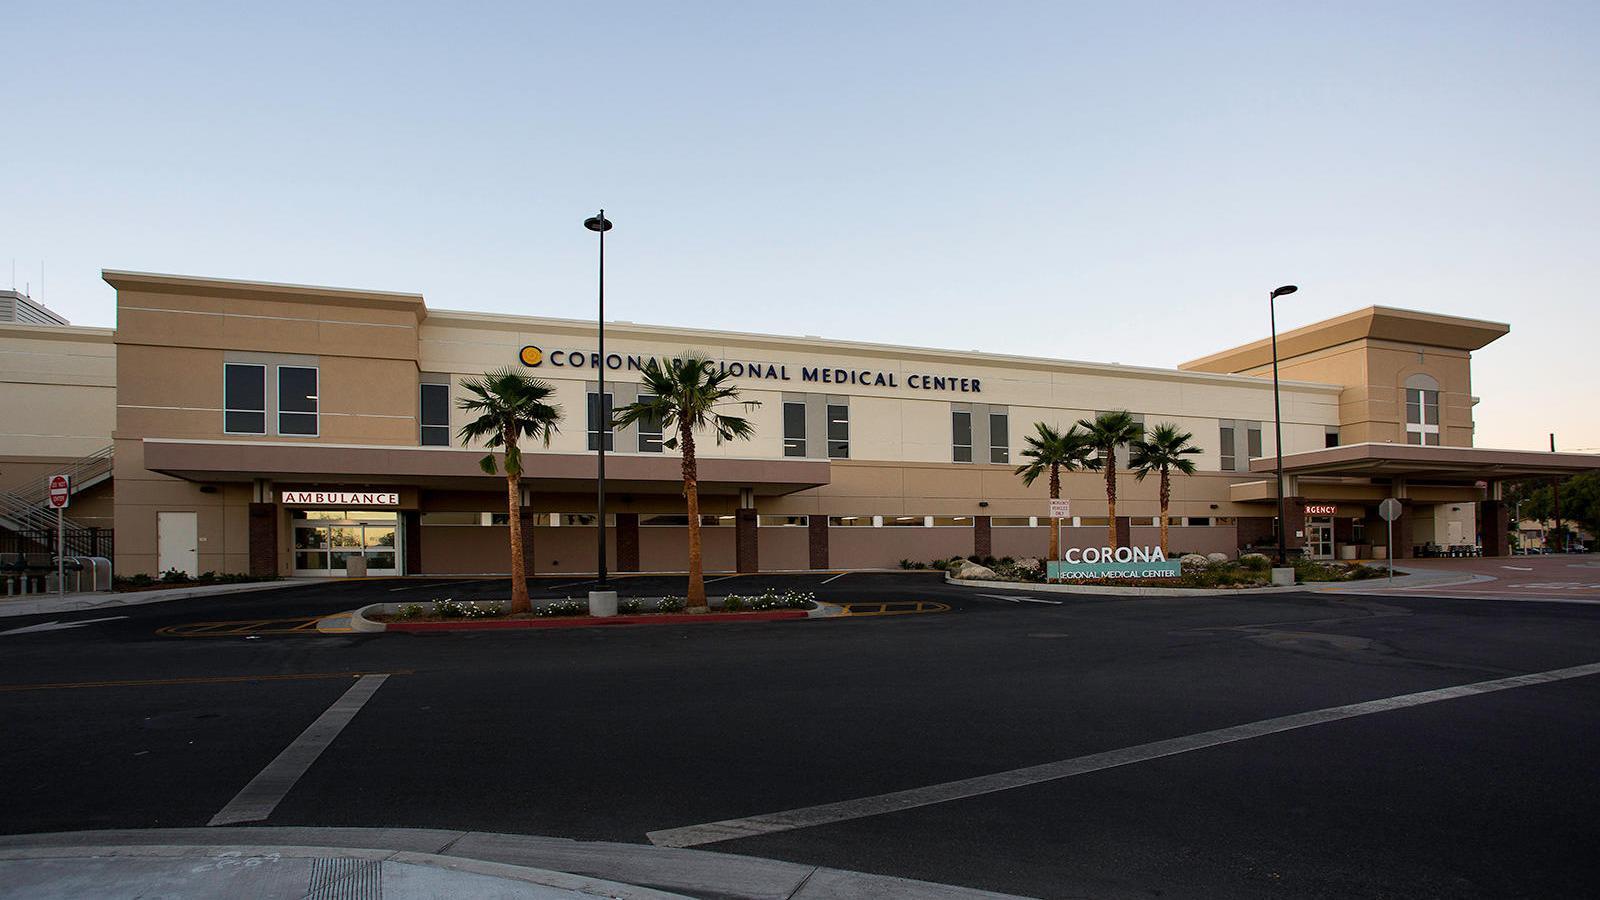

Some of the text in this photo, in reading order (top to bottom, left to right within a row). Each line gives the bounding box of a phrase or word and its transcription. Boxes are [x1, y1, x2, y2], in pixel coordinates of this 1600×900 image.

[550, 350, 658, 372] CORONA
[802, 367, 898, 387] MEDICAL
[908, 374, 982, 393] CENTER
[285, 492, 396, 504] AMBULANCE
[1304, 506, 1335, 514] RGENCY
[1065, 545, 1166, 564] CORONA
[1100, 570, 1141, 578] MEDICAL
[1142, 569, 1176, 578] CENTER
